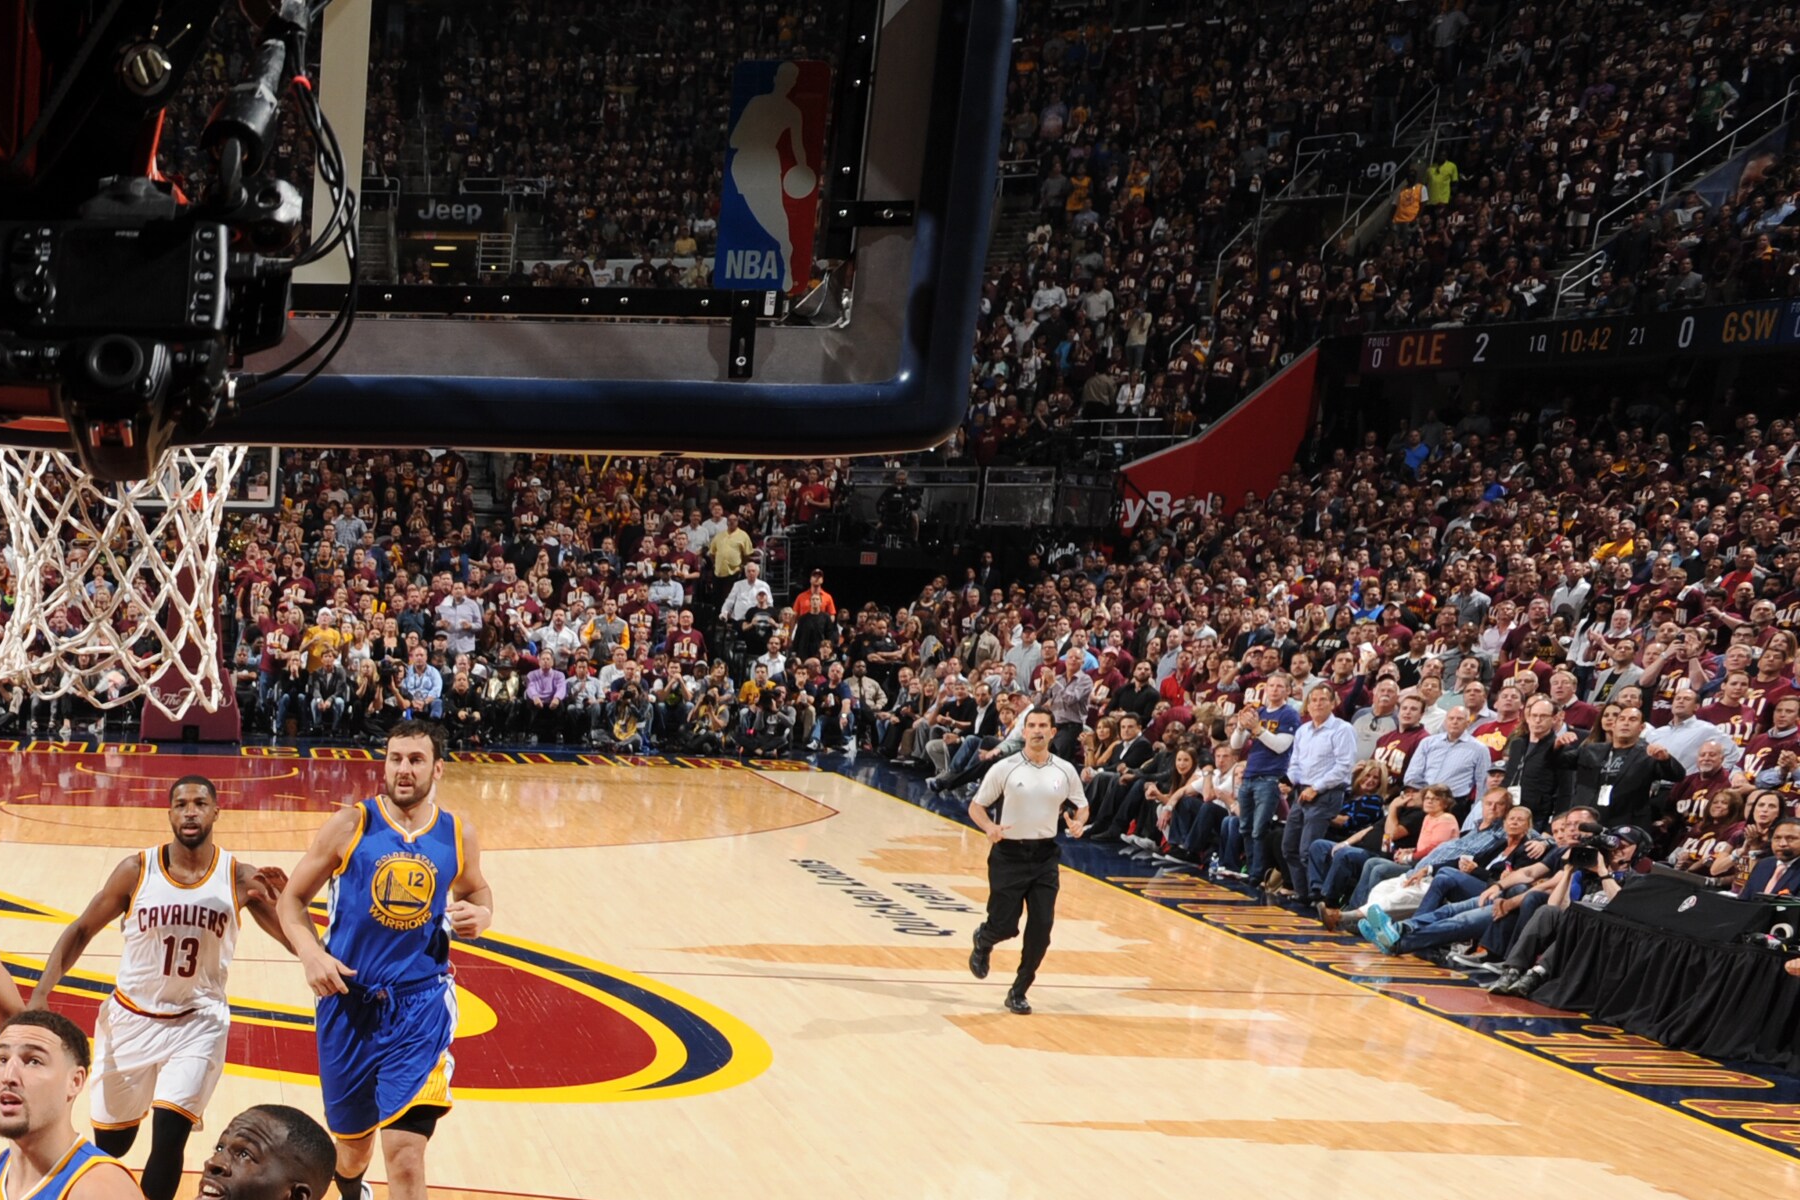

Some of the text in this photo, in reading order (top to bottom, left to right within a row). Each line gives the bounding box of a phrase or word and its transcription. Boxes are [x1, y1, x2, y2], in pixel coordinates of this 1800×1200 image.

[417, 198, 483, 225] Jeep
[725, 250, 778, 280] NBA
[1560, 328, 1612, 353] 10:42
[1627, 328, 1646, 346] 21
[1678, 316, 1694, 349] 0
[1721, 309, 1779, 345] GSW
[1367, 337, 1390, 348] FOULS
[1398, 333, 1446, 367] CLE
[1473, 332, 1490, 363] 2
[1372, 349, 1382, 369] 0
[240, 745, 823, 773] CAALIERS
[374, 851, 413, 868] GOLDEN
[407, 871, 425, 887] 12
[137, 904, 228, 939] CAVALIERS
[368, 903, 433, 931] WARRIORS
[162, 934, 200, 978] 13
